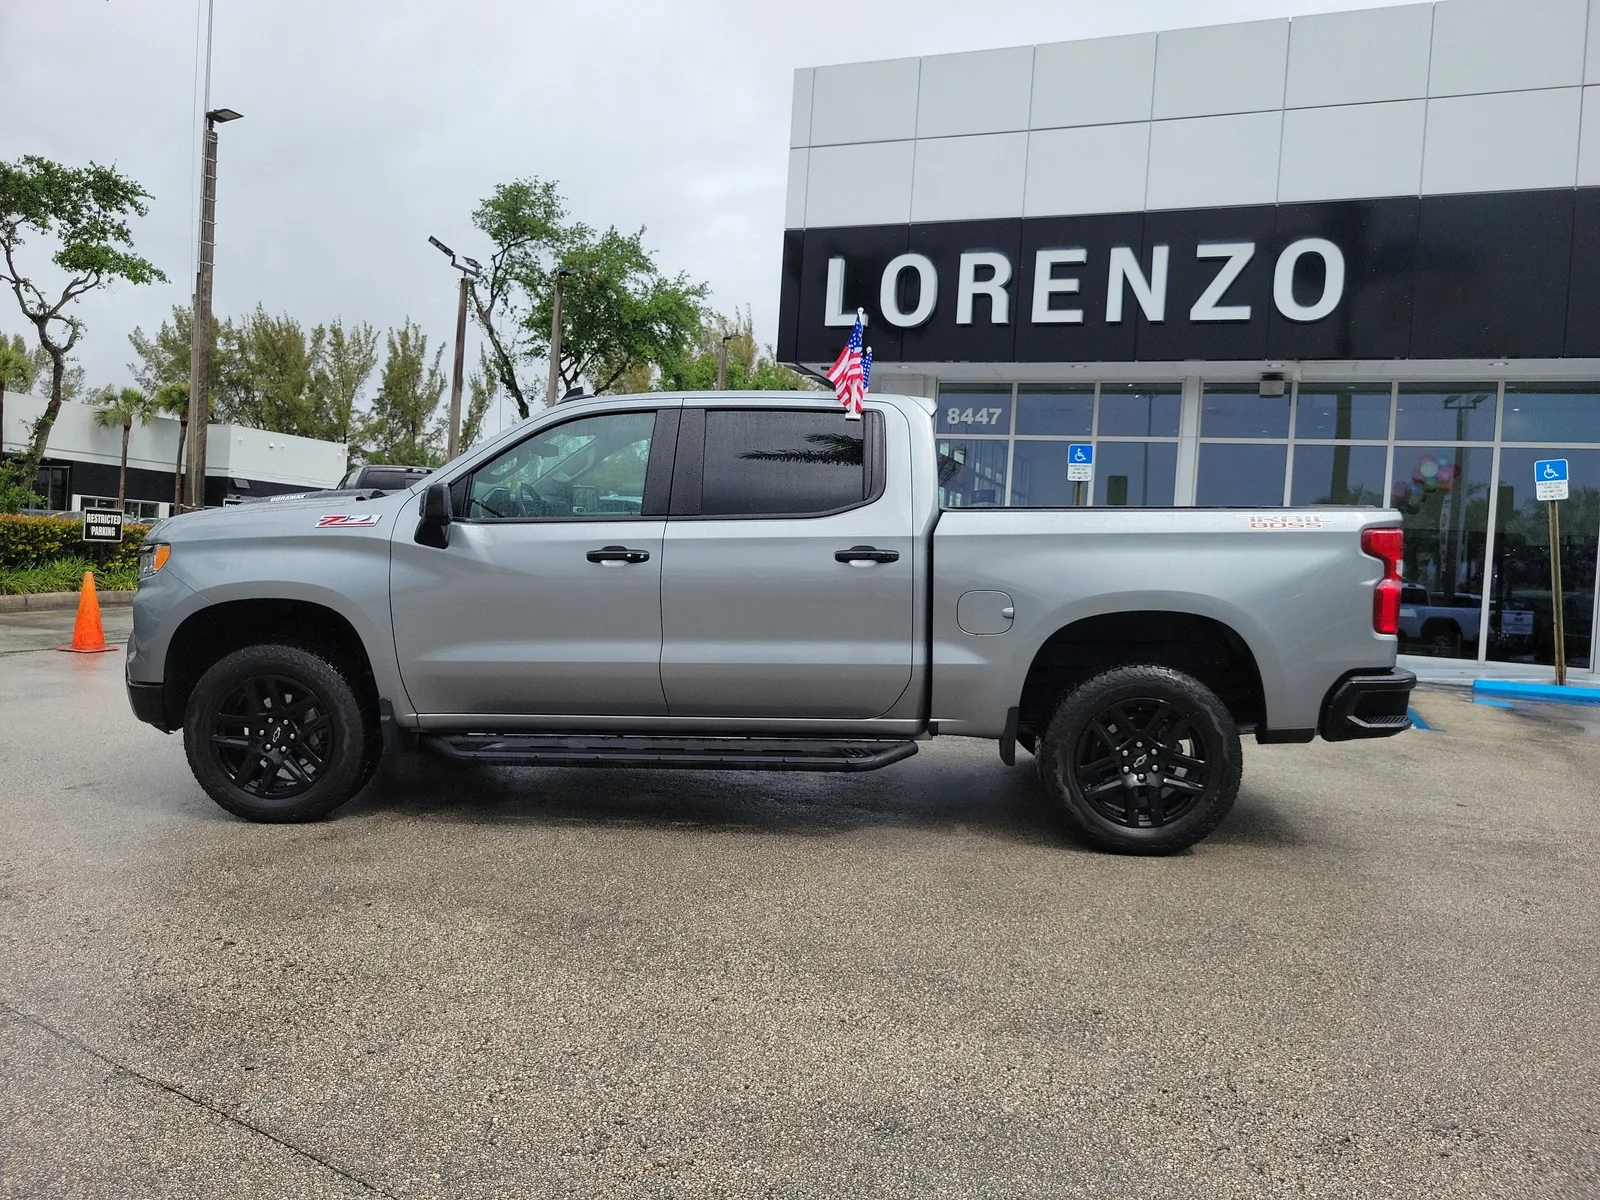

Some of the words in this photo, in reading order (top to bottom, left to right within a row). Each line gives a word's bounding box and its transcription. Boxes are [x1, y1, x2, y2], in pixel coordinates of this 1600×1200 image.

[824, 237, 1346, 328] LORENZO
[946, 407, 1003, 425] 8447
[269, 493, 307, 503] DURAMAX
[86, 513, 121, 525] RESTRICTED
[91, 526, 116, 536] PARKING
